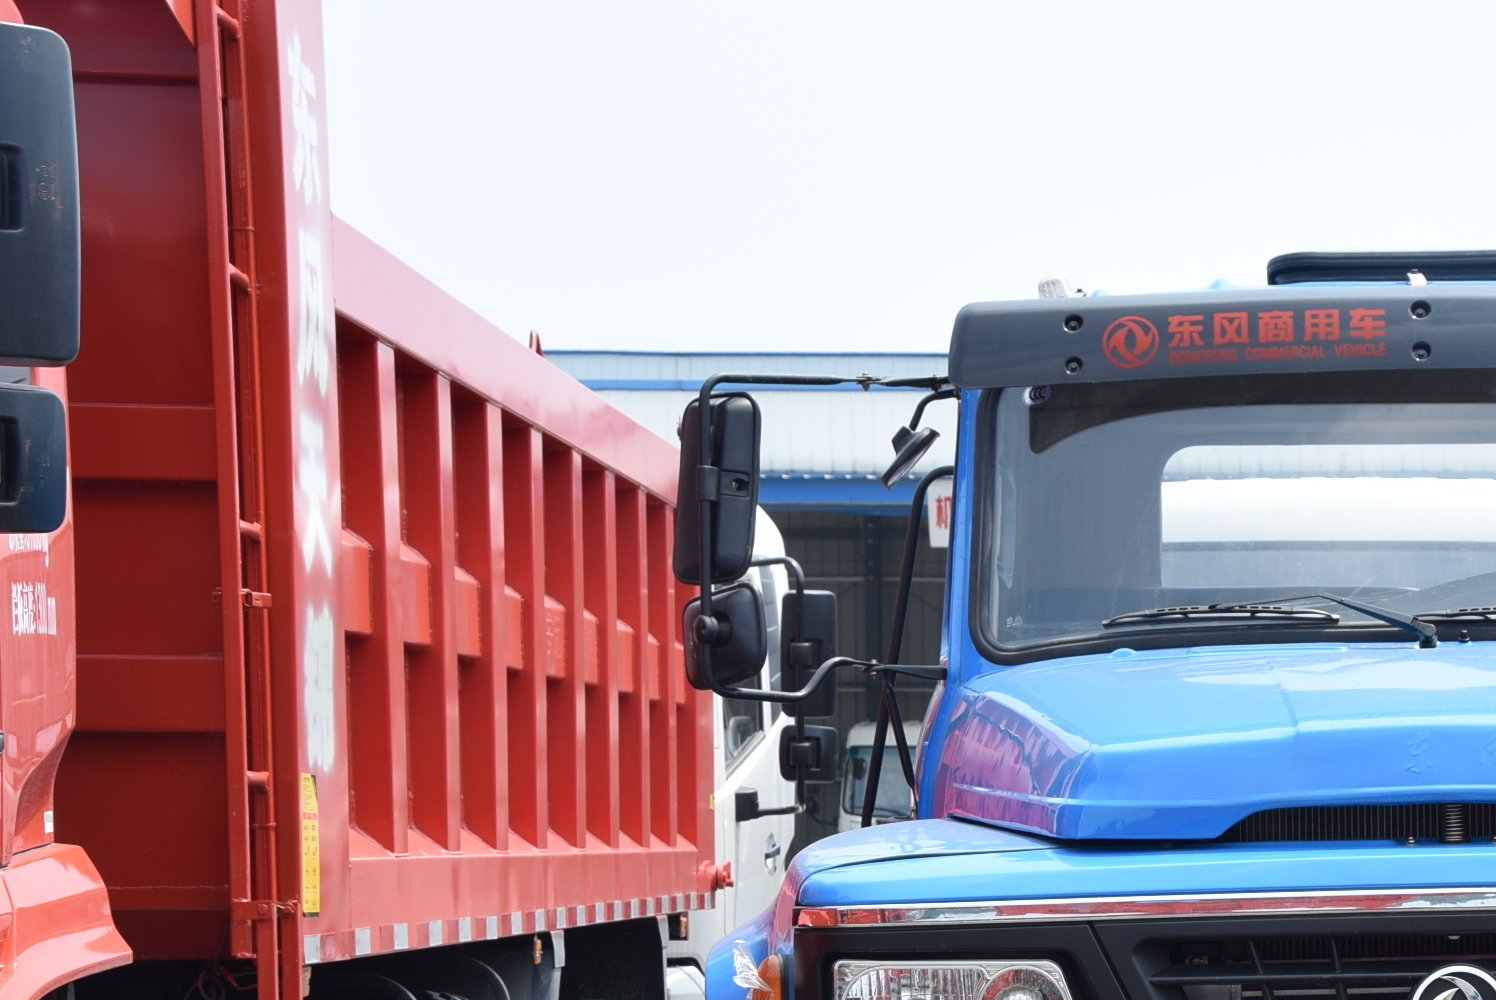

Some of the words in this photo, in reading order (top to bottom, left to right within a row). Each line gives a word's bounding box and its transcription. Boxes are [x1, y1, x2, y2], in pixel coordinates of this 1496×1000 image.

[1167, 308, 1387, 348] 东风商用车
[1168, 348, 1239, 365] DONGFENG
[1244, 345, 1326, 361] COMMERCIAL
[1333, 342, 1387, 357] VEHICLE
